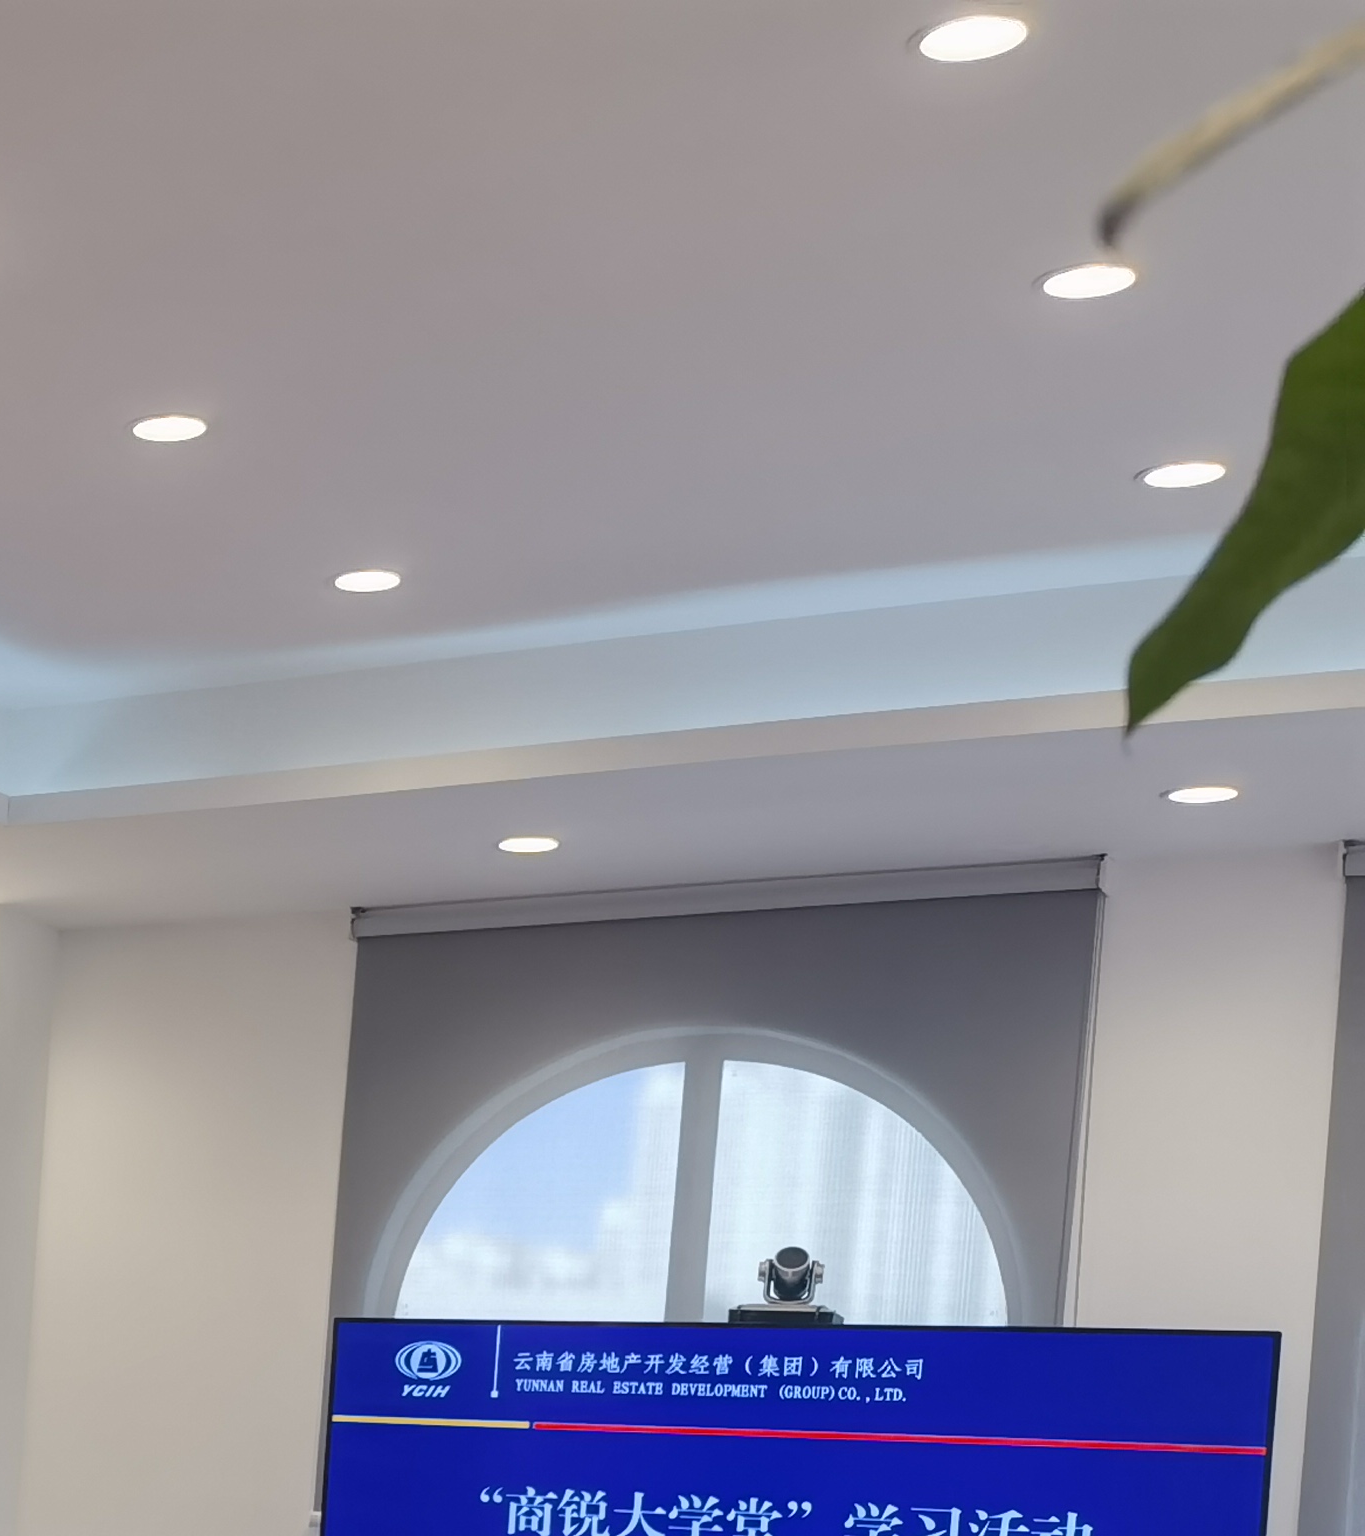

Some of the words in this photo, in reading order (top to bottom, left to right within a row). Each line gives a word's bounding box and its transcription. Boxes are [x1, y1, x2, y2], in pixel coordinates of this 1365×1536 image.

[402, 1385, 450, 1397] YCIH
[516, 1379, 564, 1392] YUNNAN
[572, 1380, 604, 1393] REAL
[613, 1381, 663, 1395] ESTATE
[672, 1383, 767, 1397] DEVELOPMENT
